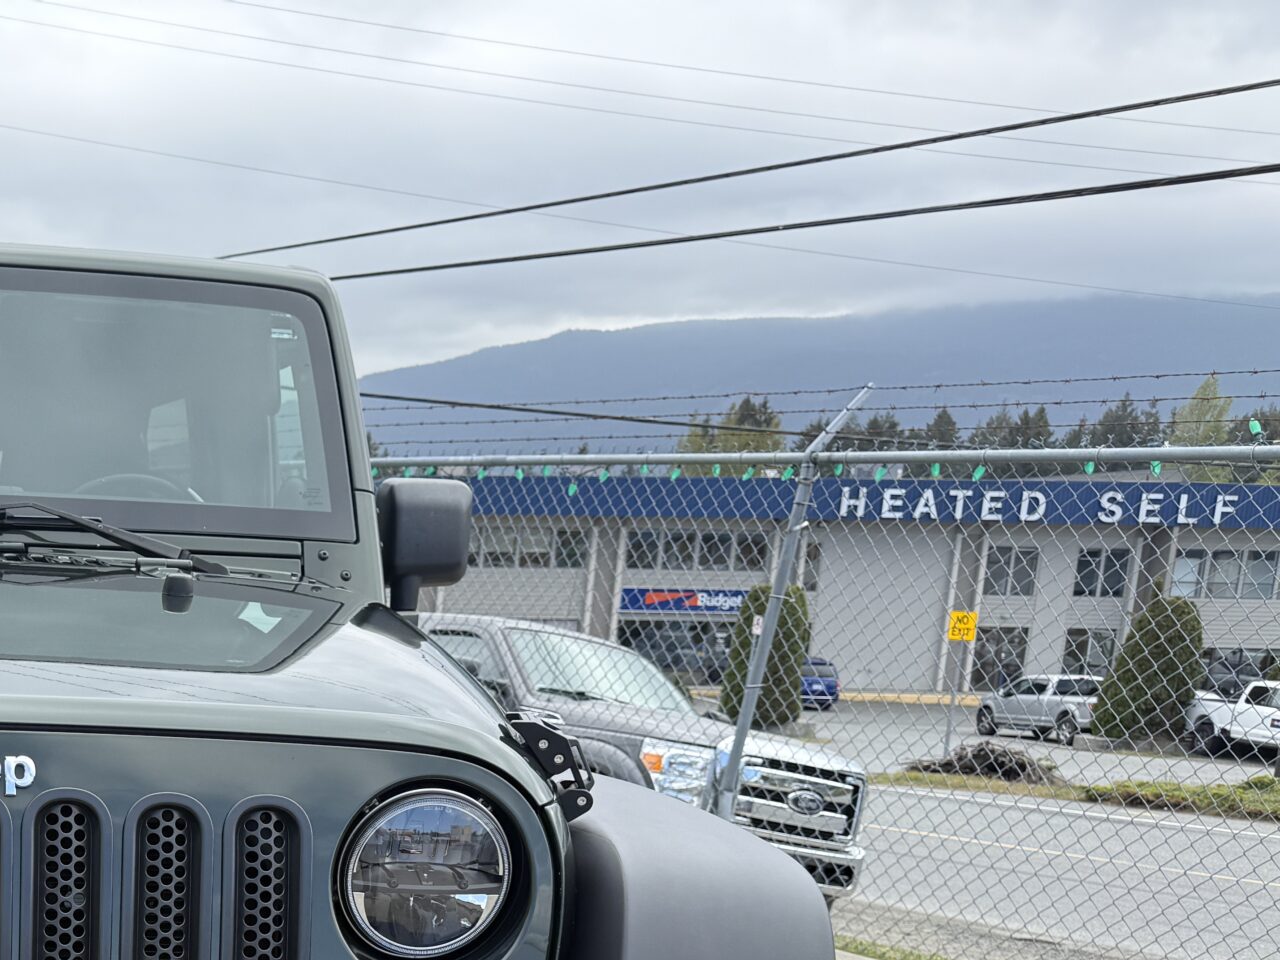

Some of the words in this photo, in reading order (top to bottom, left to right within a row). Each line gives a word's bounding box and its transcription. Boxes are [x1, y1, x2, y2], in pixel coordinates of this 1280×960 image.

[839, 486, 1047, 522] HEATED
[1098, 490, 1239, 525] SELF
[697, 592, 743, 610] Budget
[955, 614, 970, 625] NO
[951, 627, 972, 638] EXIT
